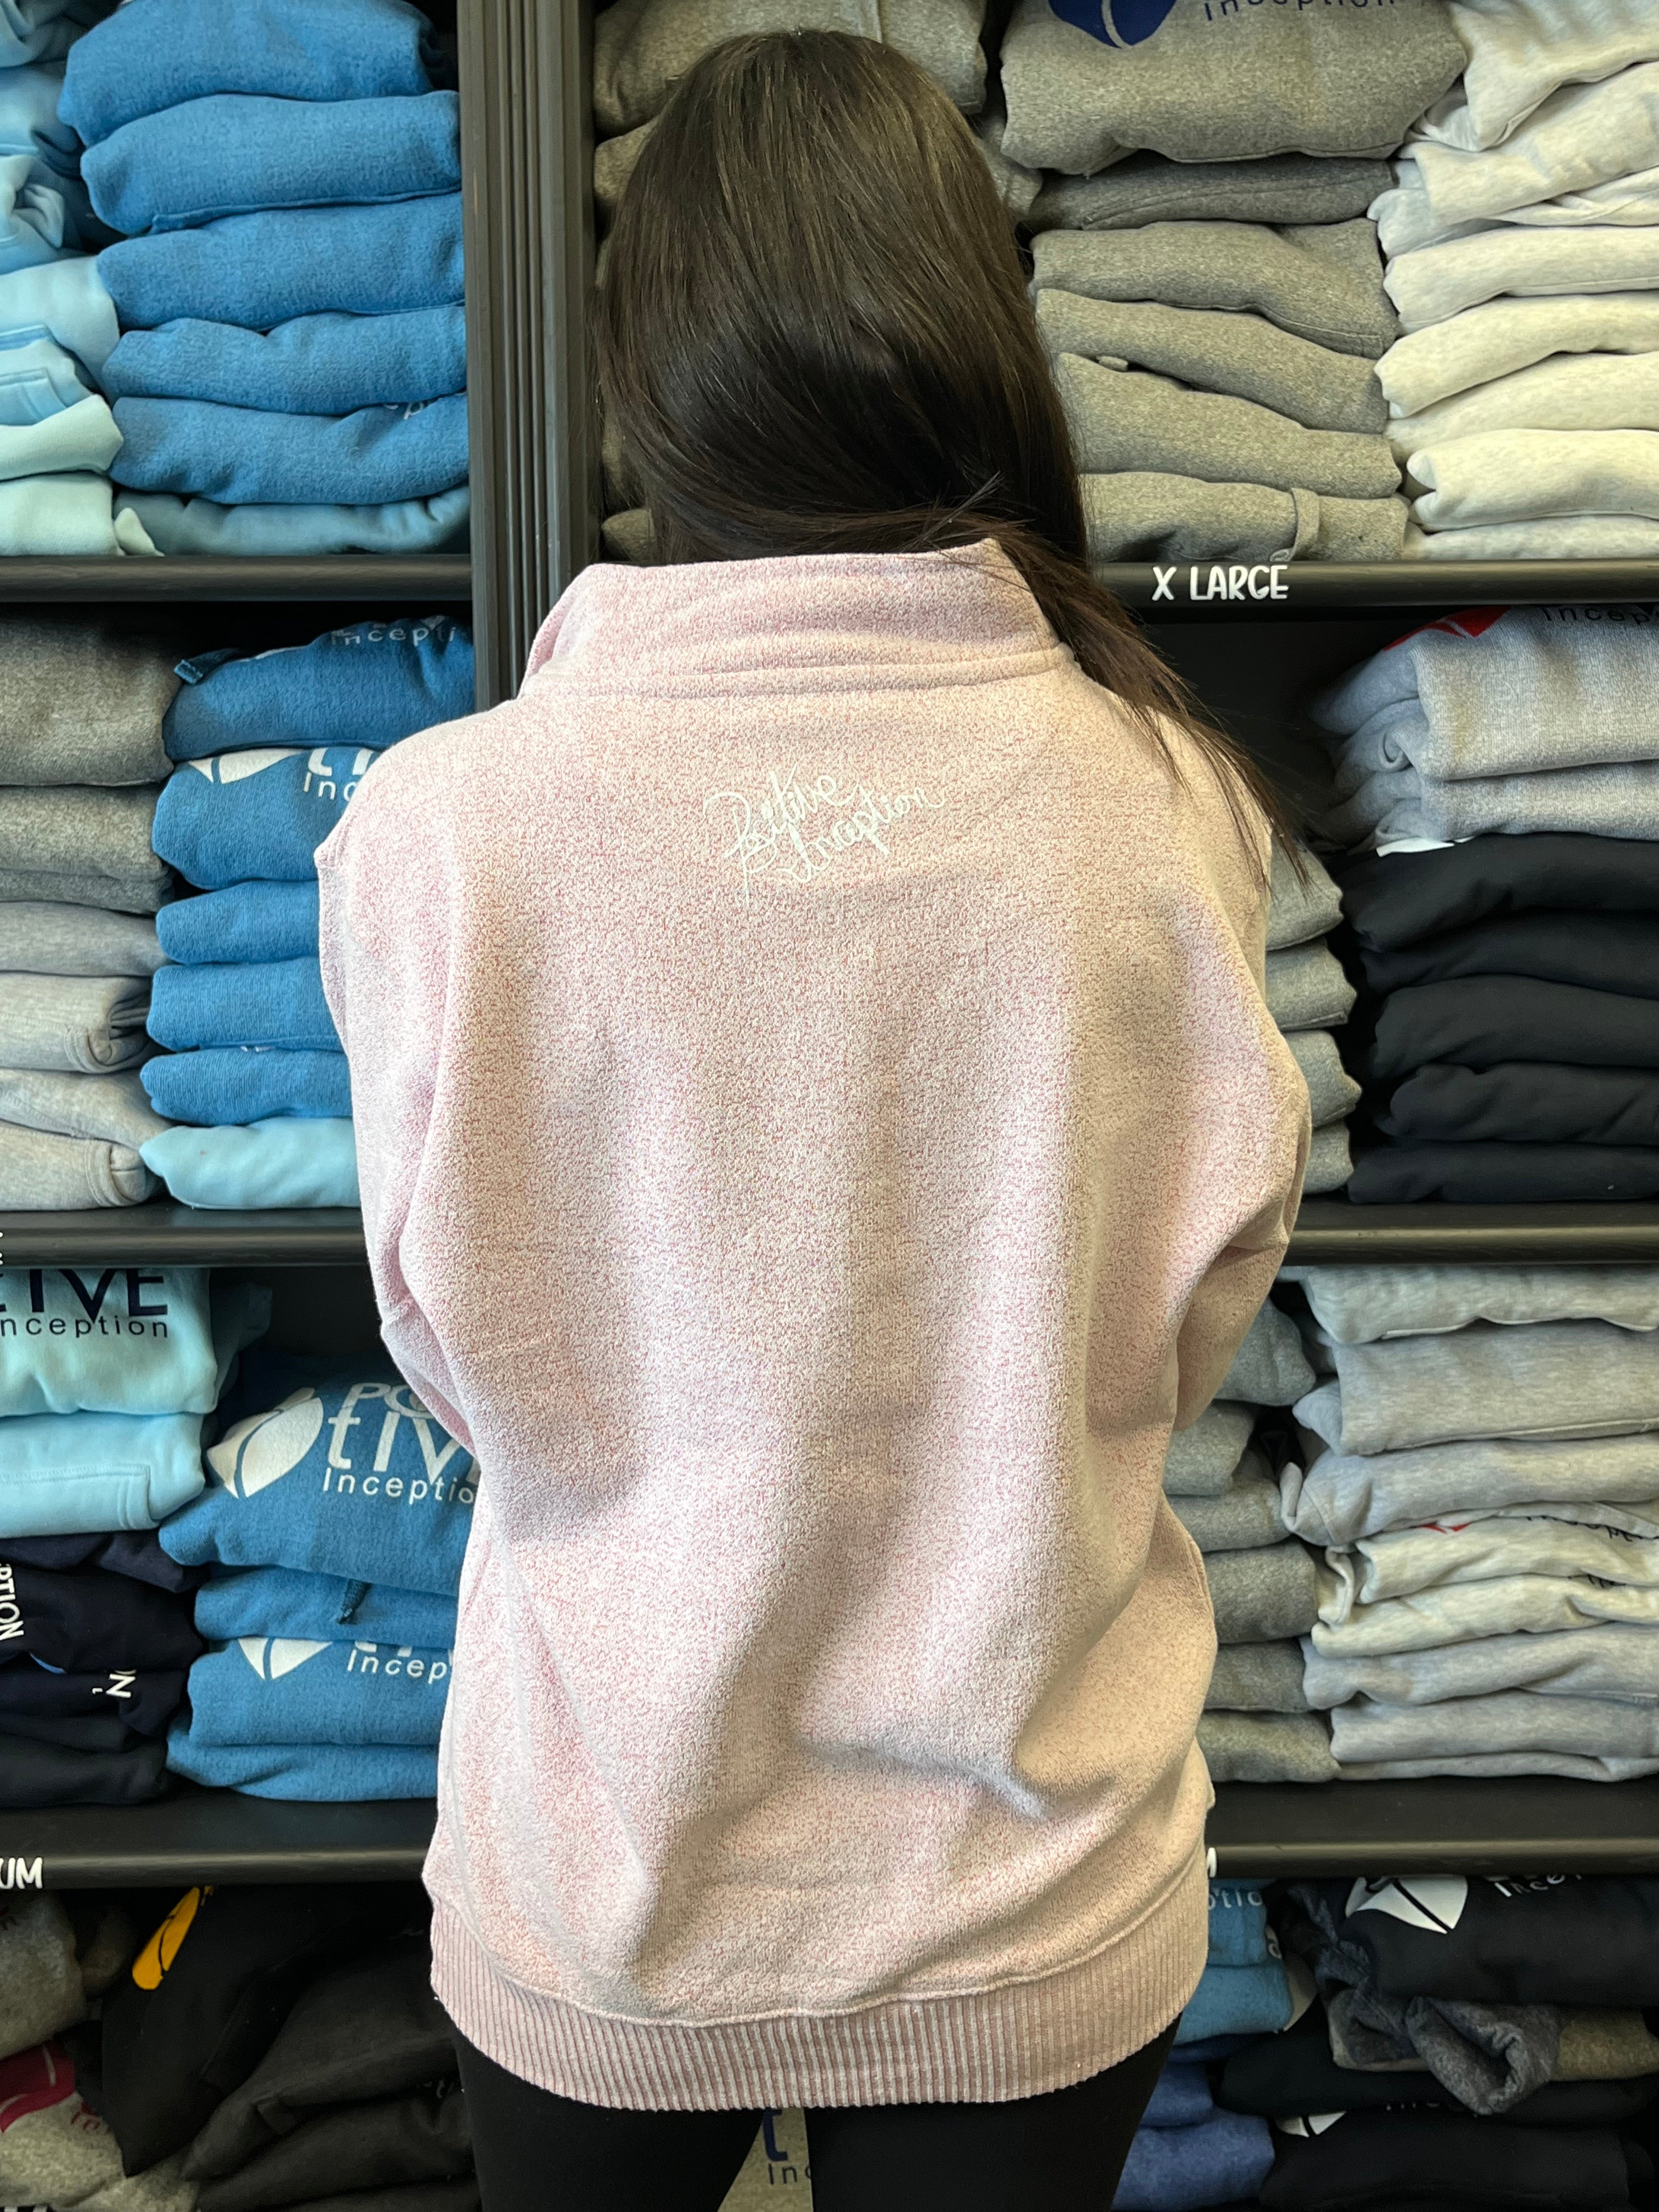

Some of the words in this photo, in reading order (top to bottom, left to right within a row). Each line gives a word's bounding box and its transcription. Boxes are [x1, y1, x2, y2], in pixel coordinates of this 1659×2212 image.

[1152, 566, 1177, 601] X
[1190, 565, 1289, 600] LARGE
[0, 1268, 168, 1324] IVE
[0, 1316, 168, 1338] nception
[328, 1407, 481, 1485] tIV
[323, 1468, 475, 1505] Inceptio
[0, 1564, 24, 1641] PTION
[347, 1649, 448, 1685] Incep
